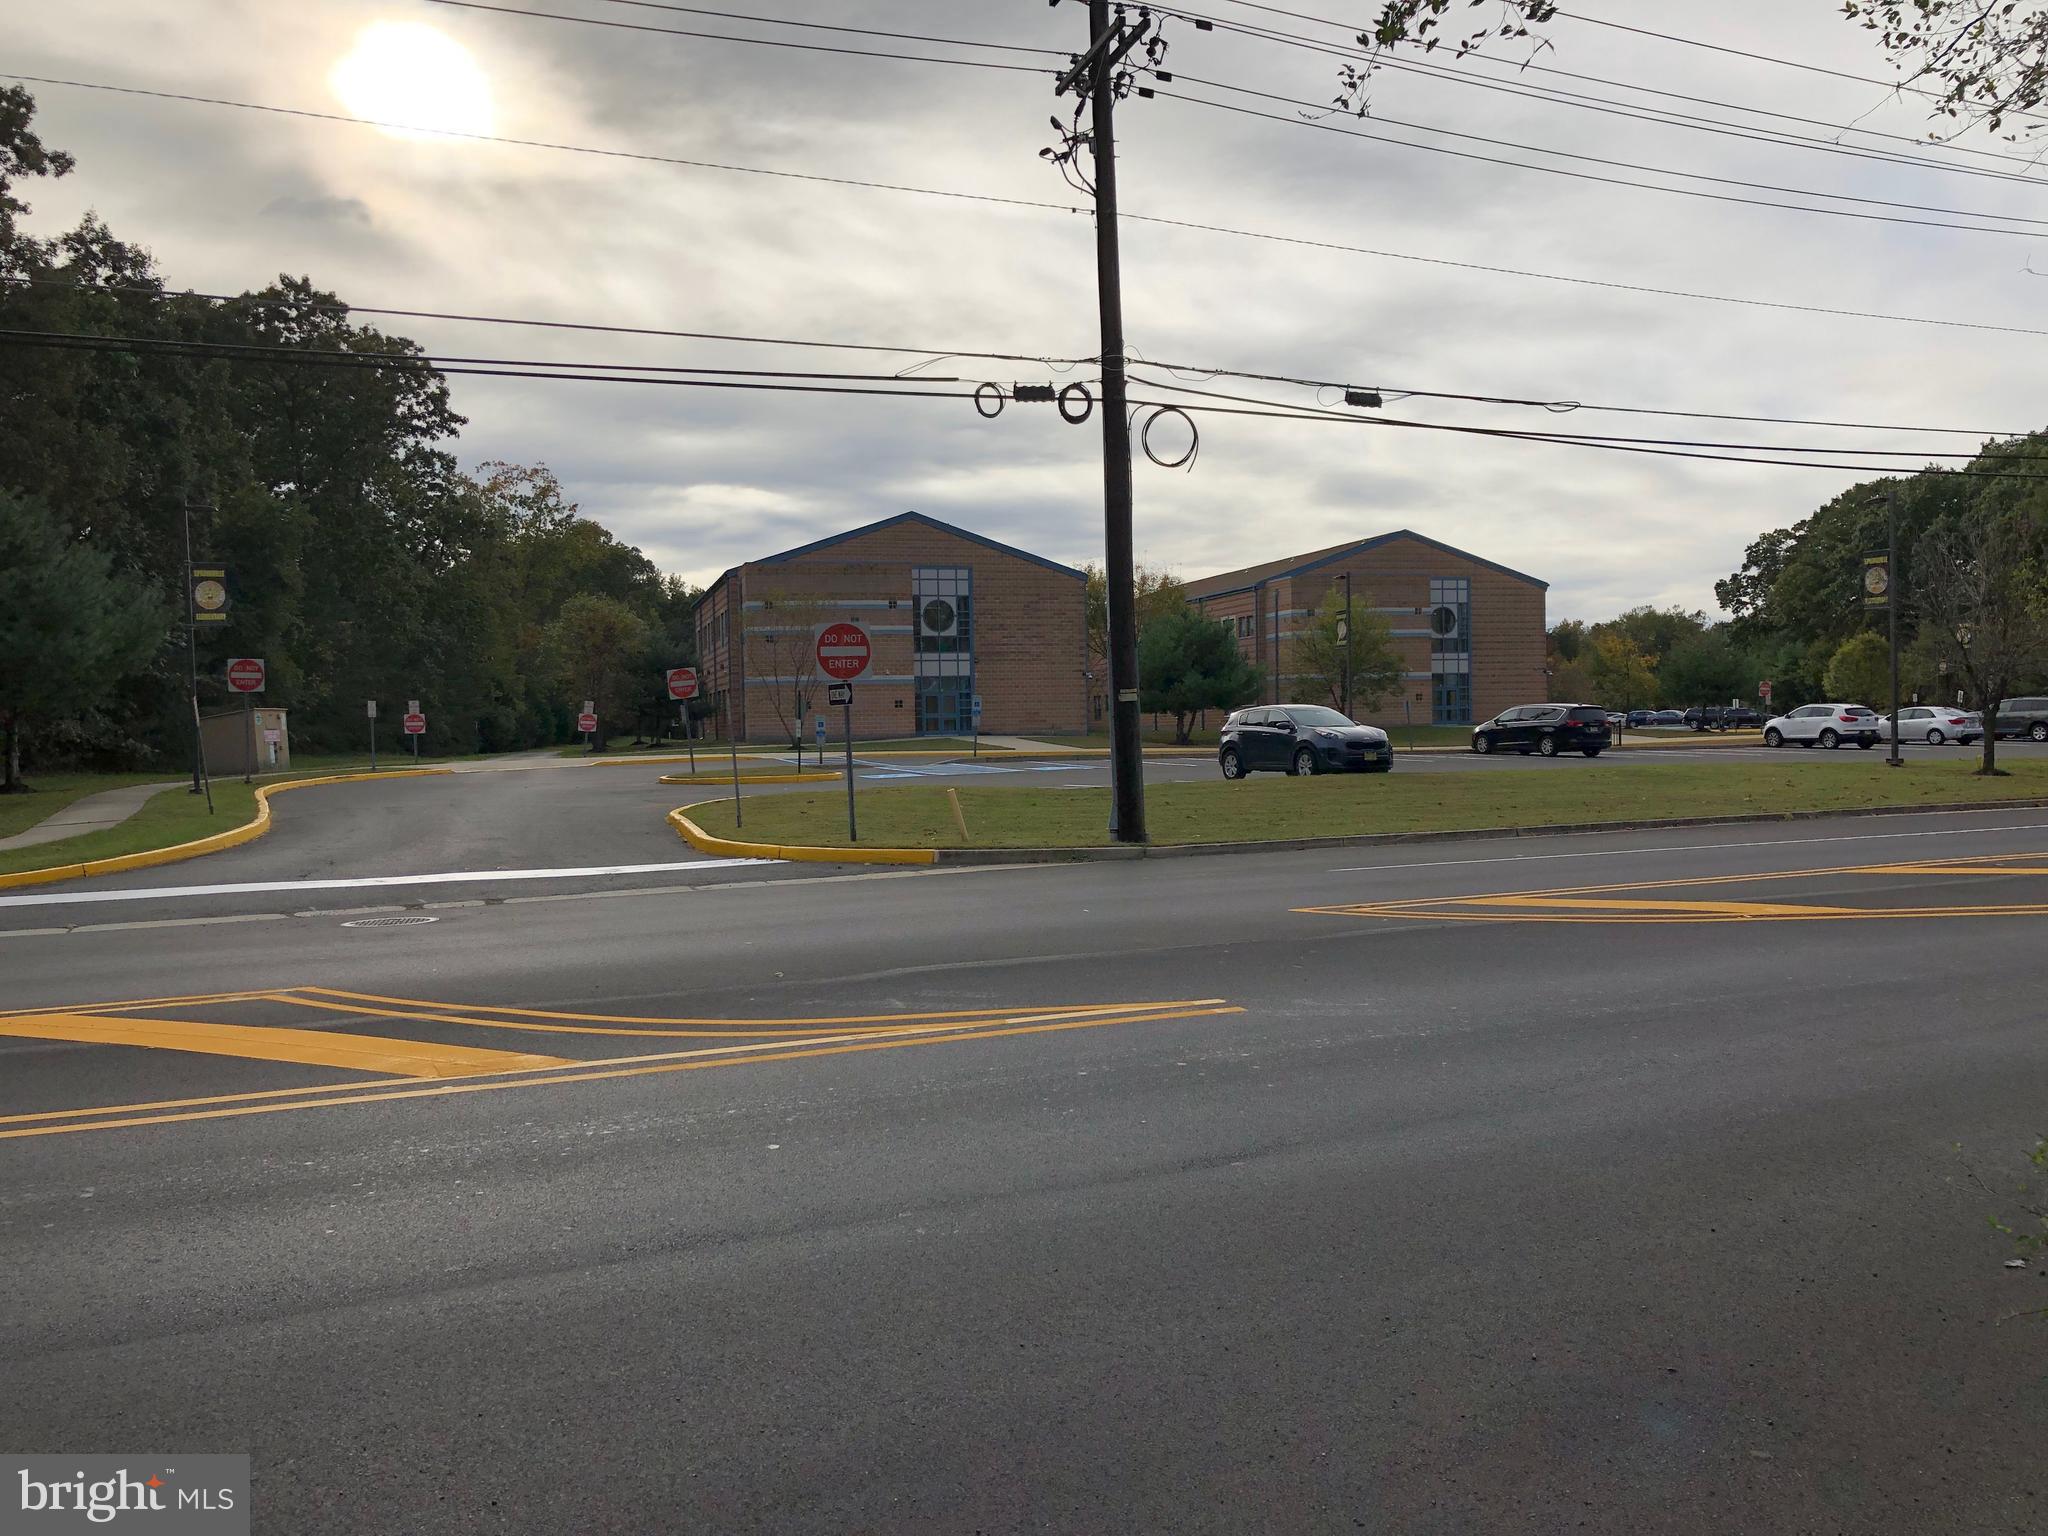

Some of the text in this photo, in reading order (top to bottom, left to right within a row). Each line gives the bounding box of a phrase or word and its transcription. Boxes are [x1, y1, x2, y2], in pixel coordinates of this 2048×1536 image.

[824, 634, 863, 643] DO NOT
[829, 659, 859, 668] ENTER
